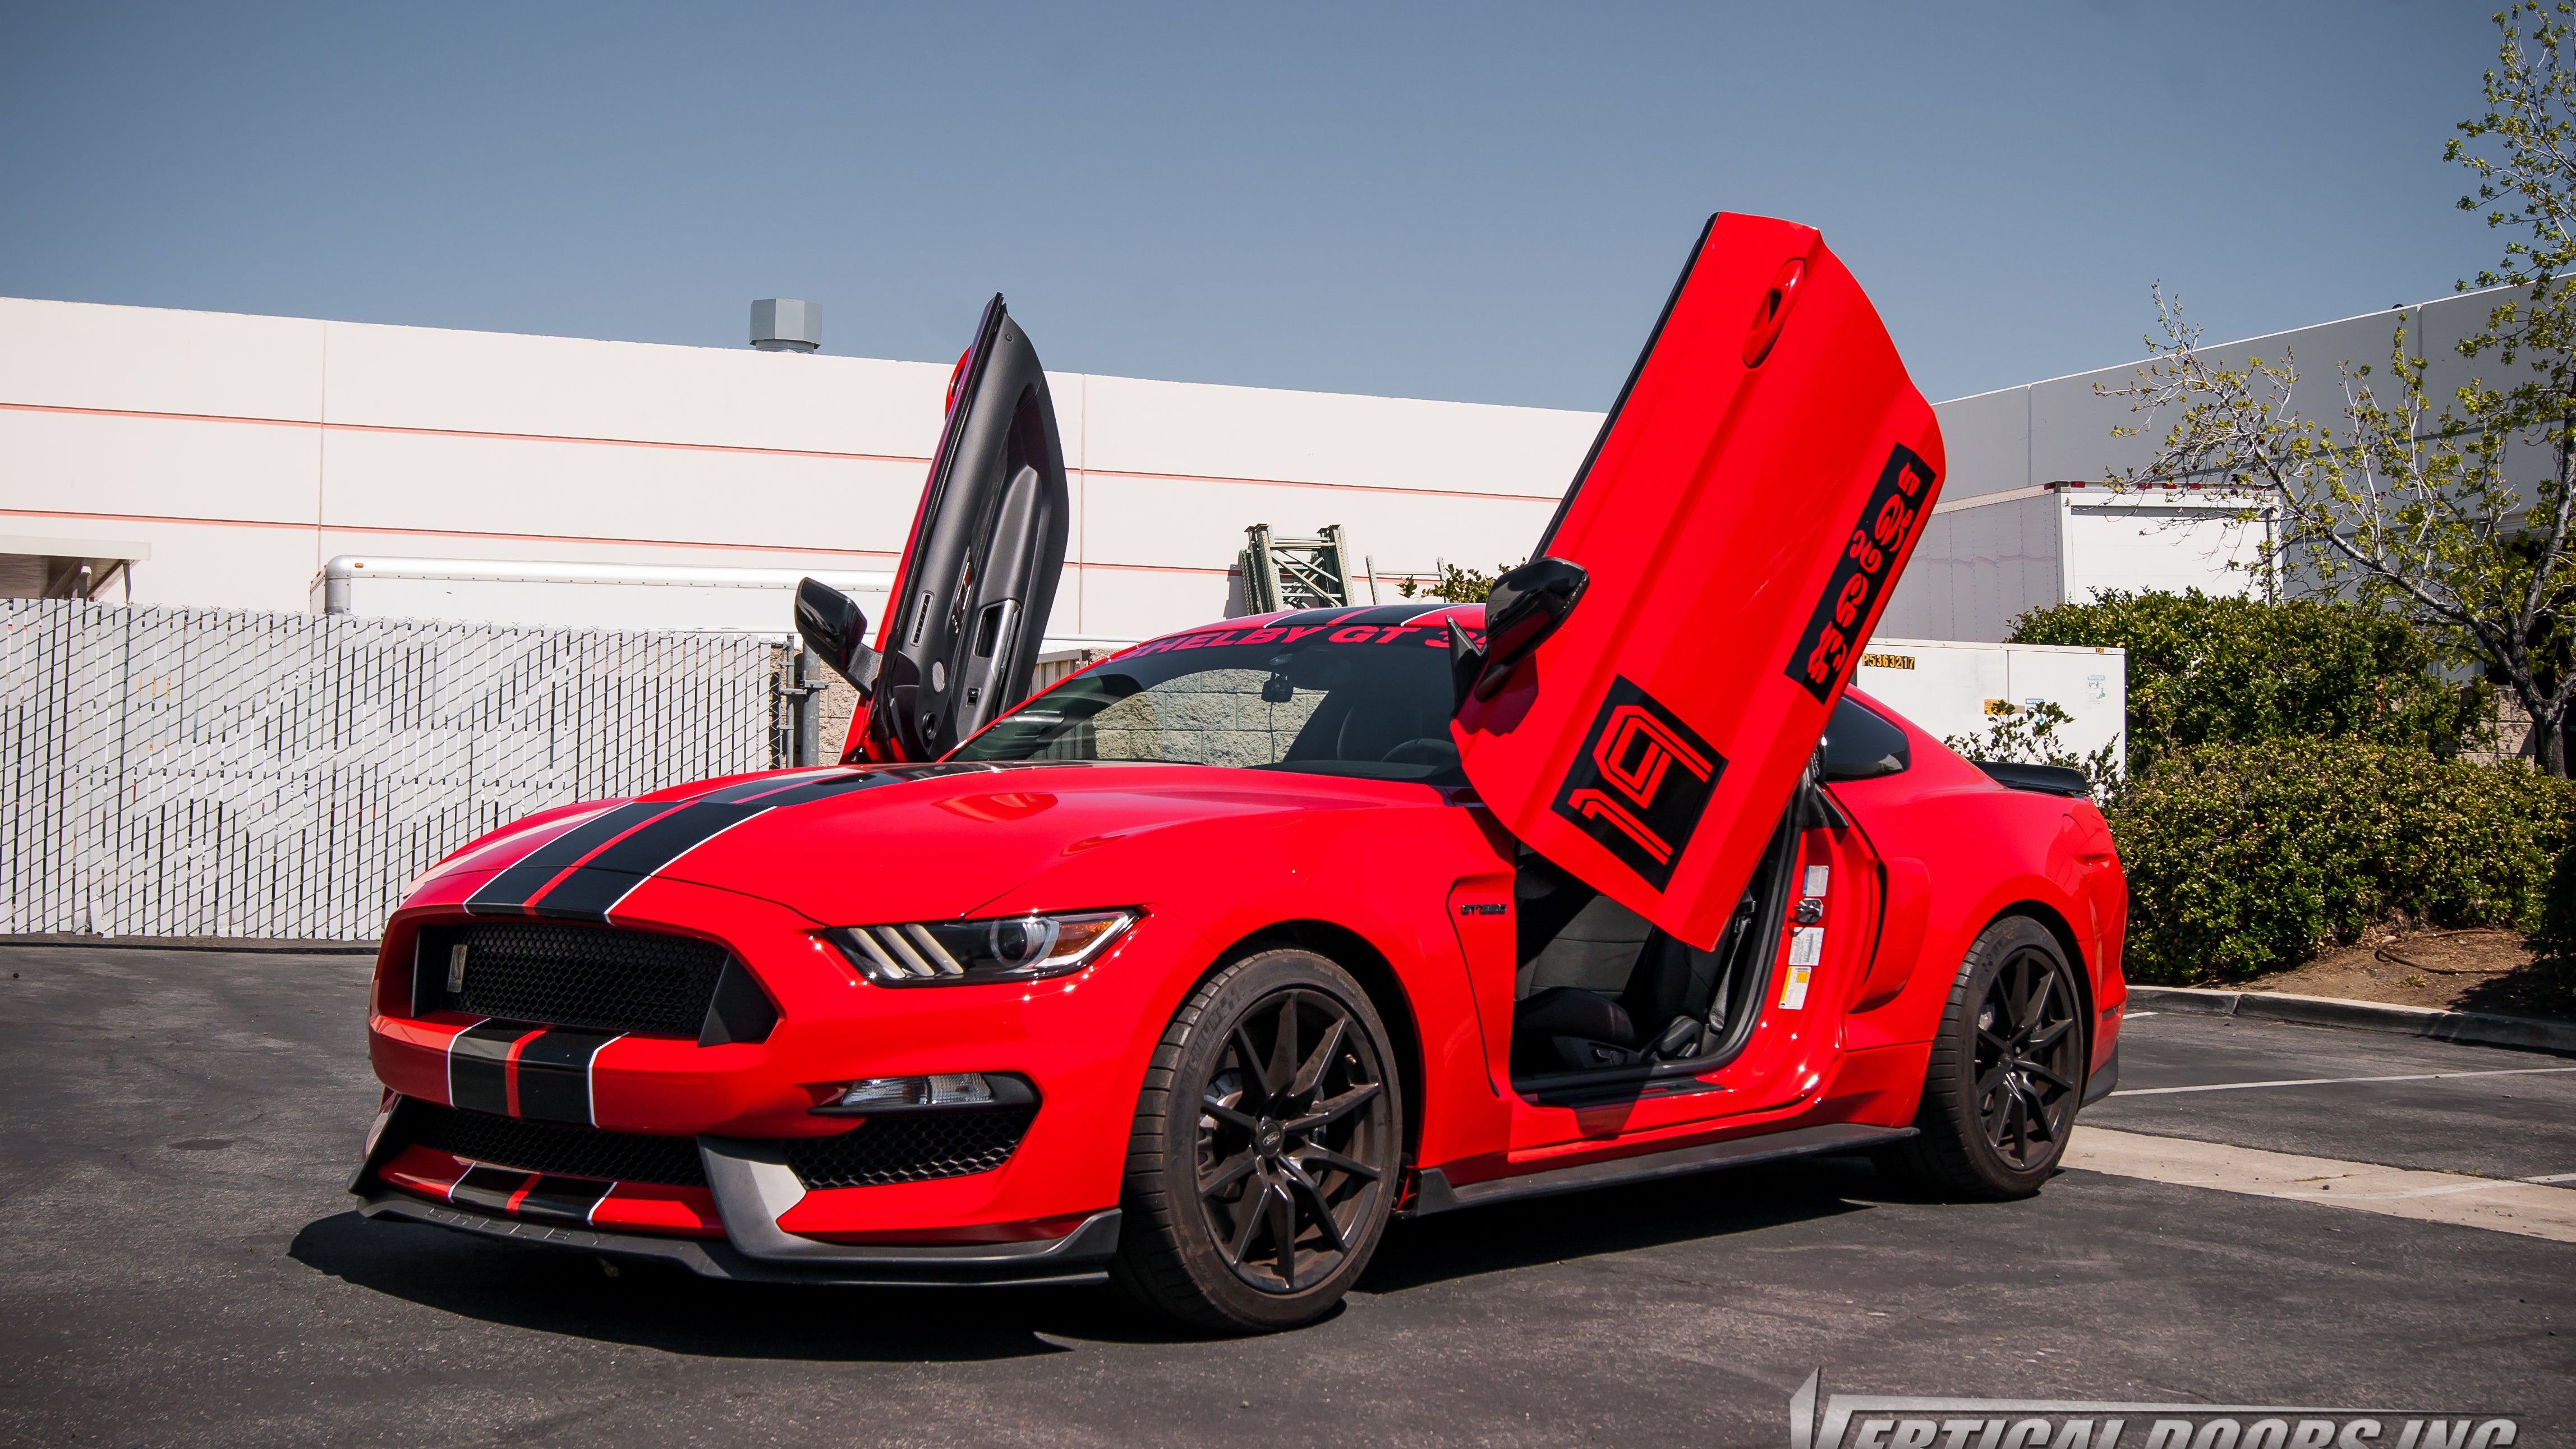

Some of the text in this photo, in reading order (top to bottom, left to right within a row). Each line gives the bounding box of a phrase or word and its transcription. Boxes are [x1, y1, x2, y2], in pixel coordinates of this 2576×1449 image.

[1104, 627, 1328, 664] SHELBY
[1328, 627, 1422, 644] GT
[1862, 653, 1915, 670] P5363217
[1567, 705, 1714, 866] 19
